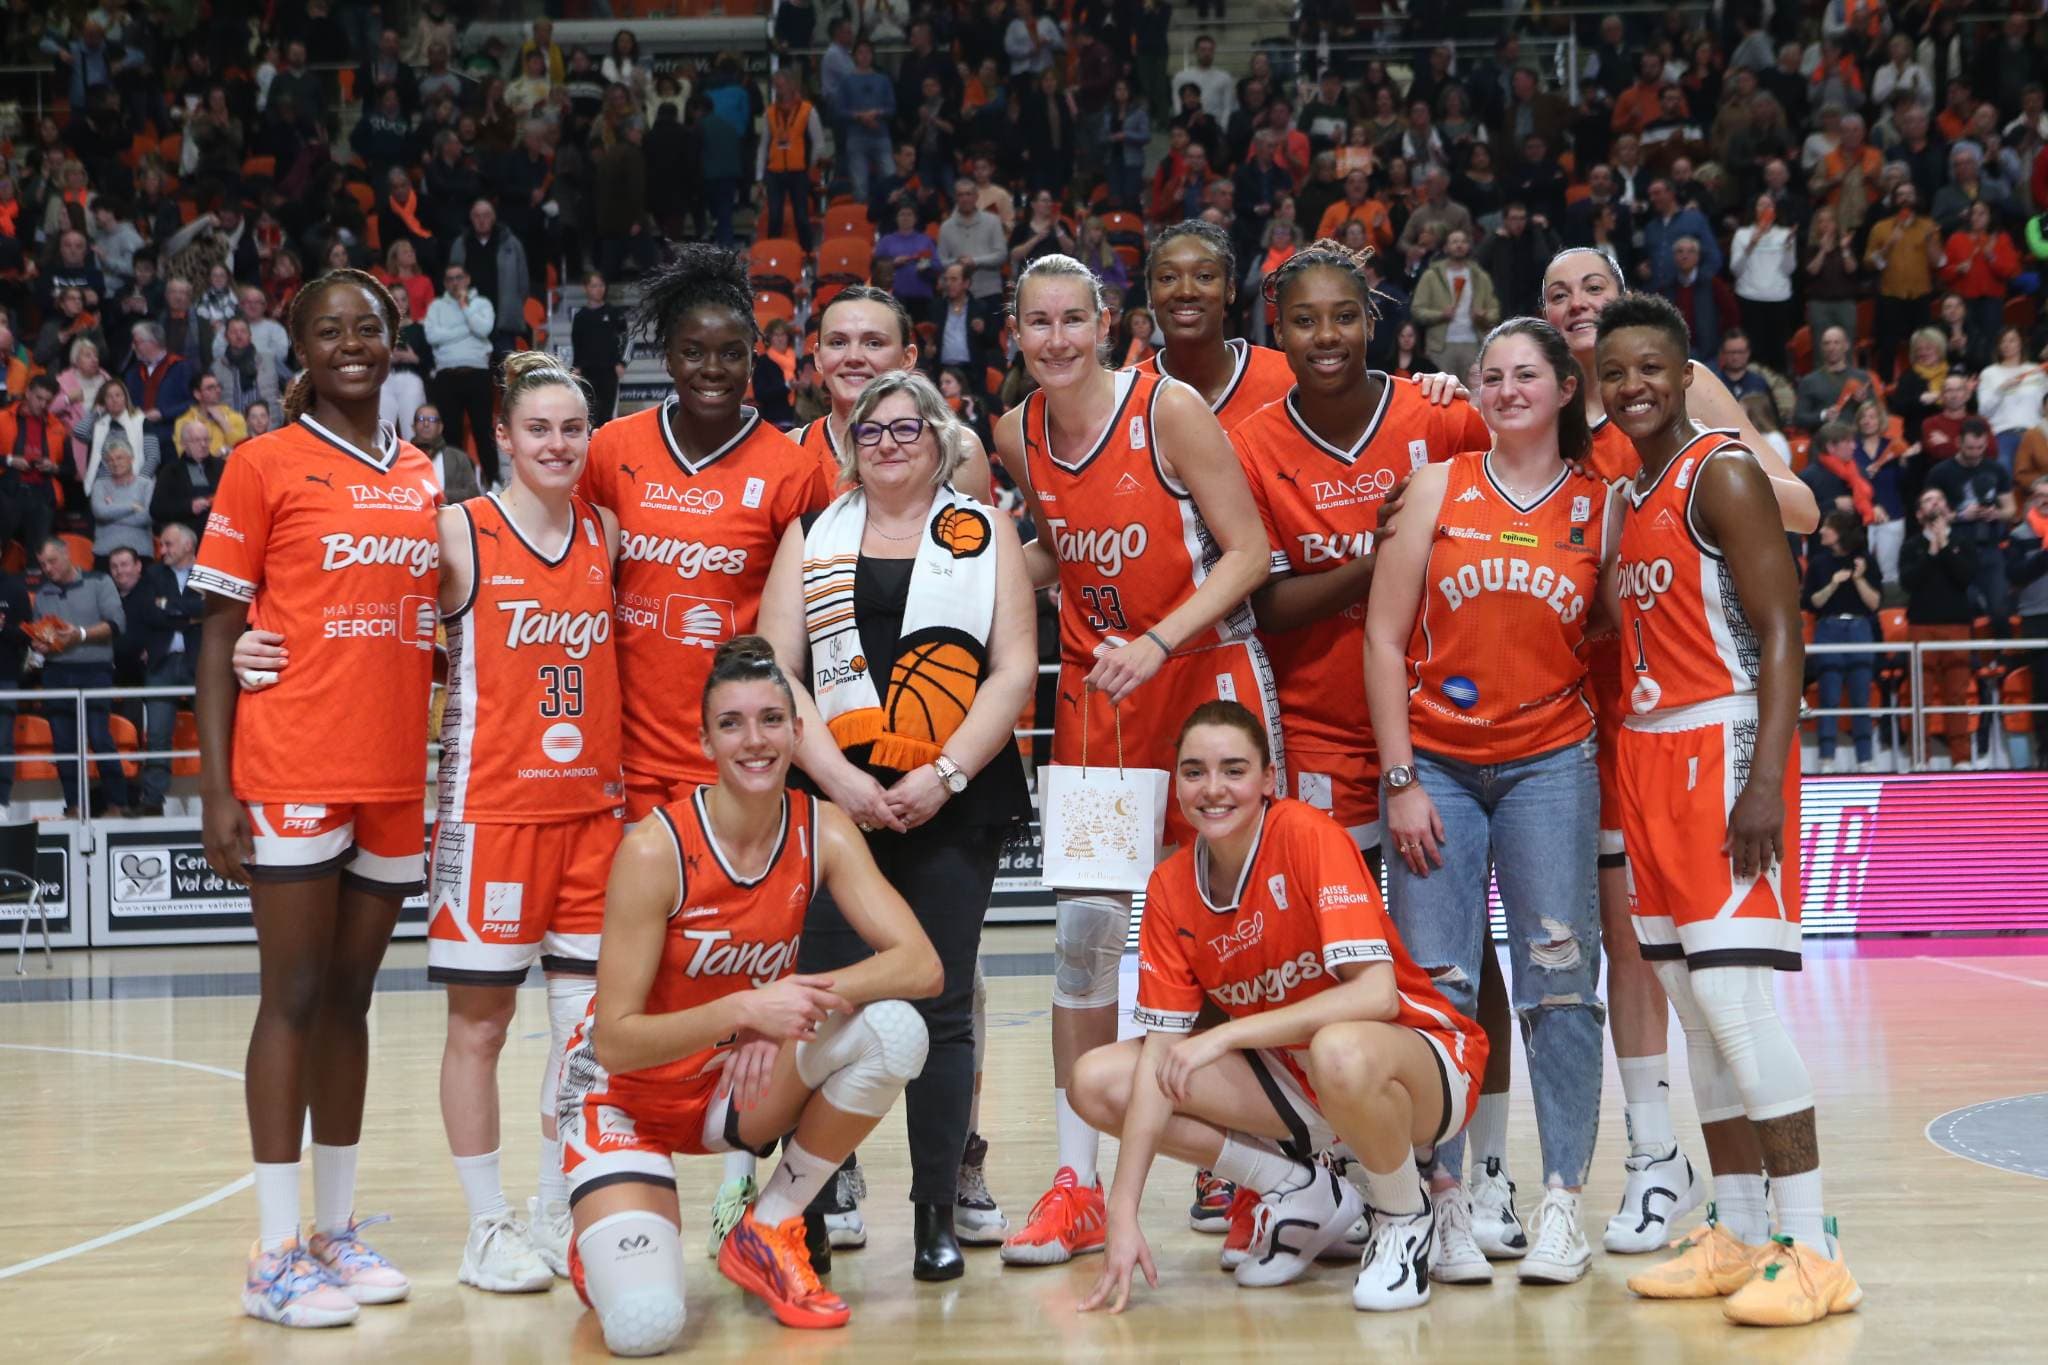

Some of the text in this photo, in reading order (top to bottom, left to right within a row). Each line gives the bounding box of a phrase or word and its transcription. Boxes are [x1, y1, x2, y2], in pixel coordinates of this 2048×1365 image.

[345, 485, 424, 506] TANGO
[644, 483, 724, 510] TANGO
[1310, 468, 1396, 502] TANGO
[208, 512, 231, 526] ISSE
[640, 501, 678, 511] BOURGES
[205, 521, 246, 543] PARGNE
[320, 533, 439, 578] Bourge
[618, 529, 748, 580] Bourges
[1046, 517, 1149, 578] Tango
[1438, 557, 1585, 625] BOURGES
[1616, 553, 1673, 611] ango
[323, 602, 397, 617] MAISONS
[615, 603, 658, 629] ERCPI
[1081, 584, 1129, 631] 33
[323, 618, 396, 639] SERCPI
[496, 599, 610, 660] Tango
[1634, 617, 1648, 673] 1
[538, 664, 585, 719] 39
[518, 768, 561, 779] KONICA
[562, 766, 599, 778] MINOLTA
[174, 853, 213, 871] Cen
[1013, 852, 1035, 870] de
[176, 874, 202, 892] Val
[203, 874, 224, 892] de
[480, 922, 521, 933] PHM
[683, 928, 800, 988] Tango
